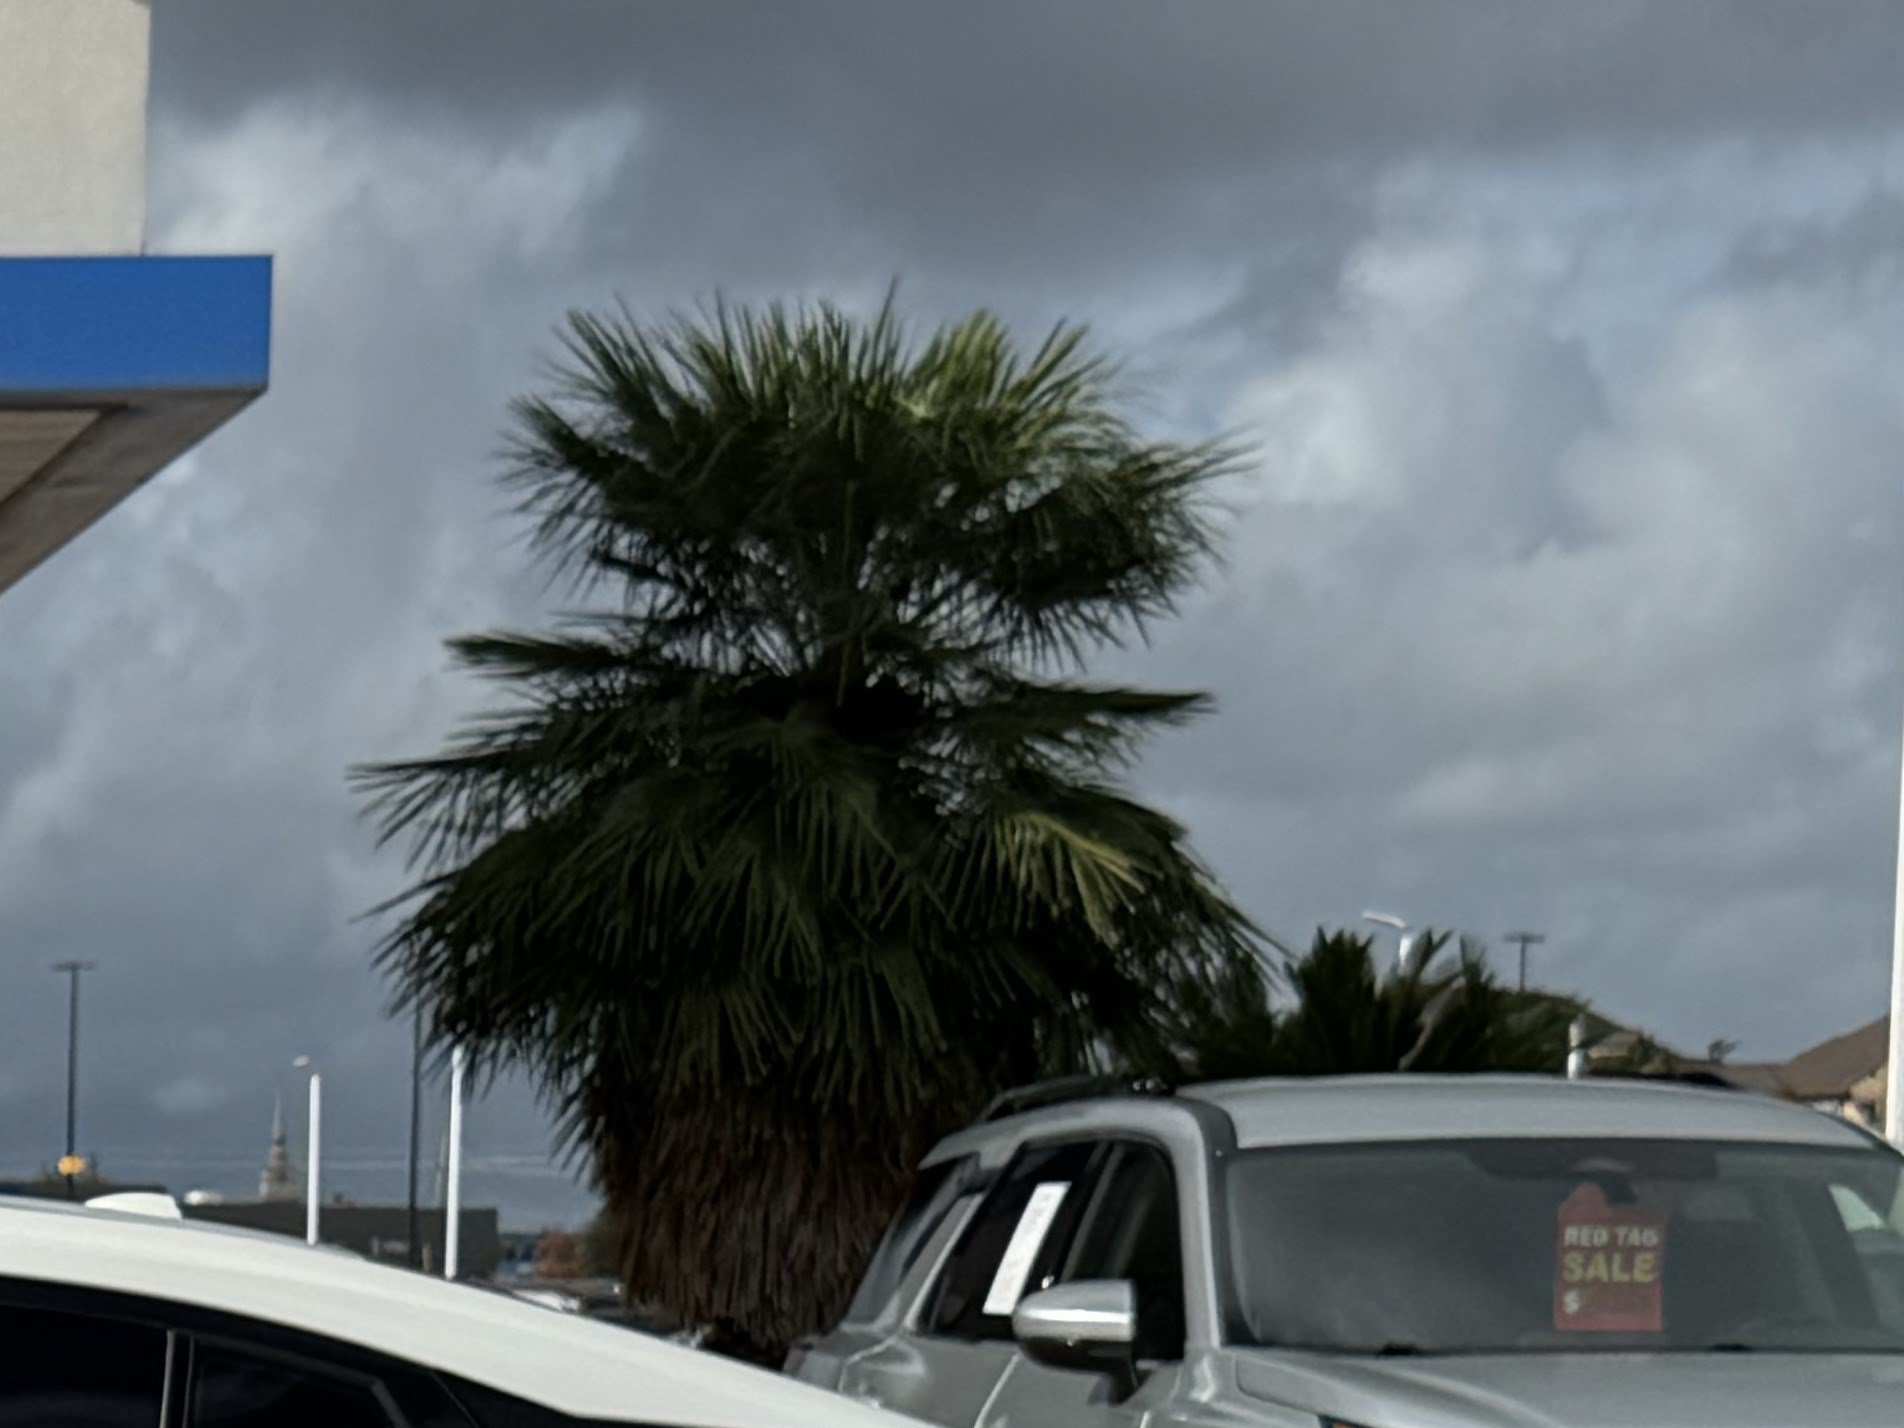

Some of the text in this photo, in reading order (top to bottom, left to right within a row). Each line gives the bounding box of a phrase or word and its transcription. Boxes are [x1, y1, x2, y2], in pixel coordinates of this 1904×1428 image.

[1563, 1225, 1660, 1248] RED TAG
[1562, 1251, 1658, 1283] SALE
